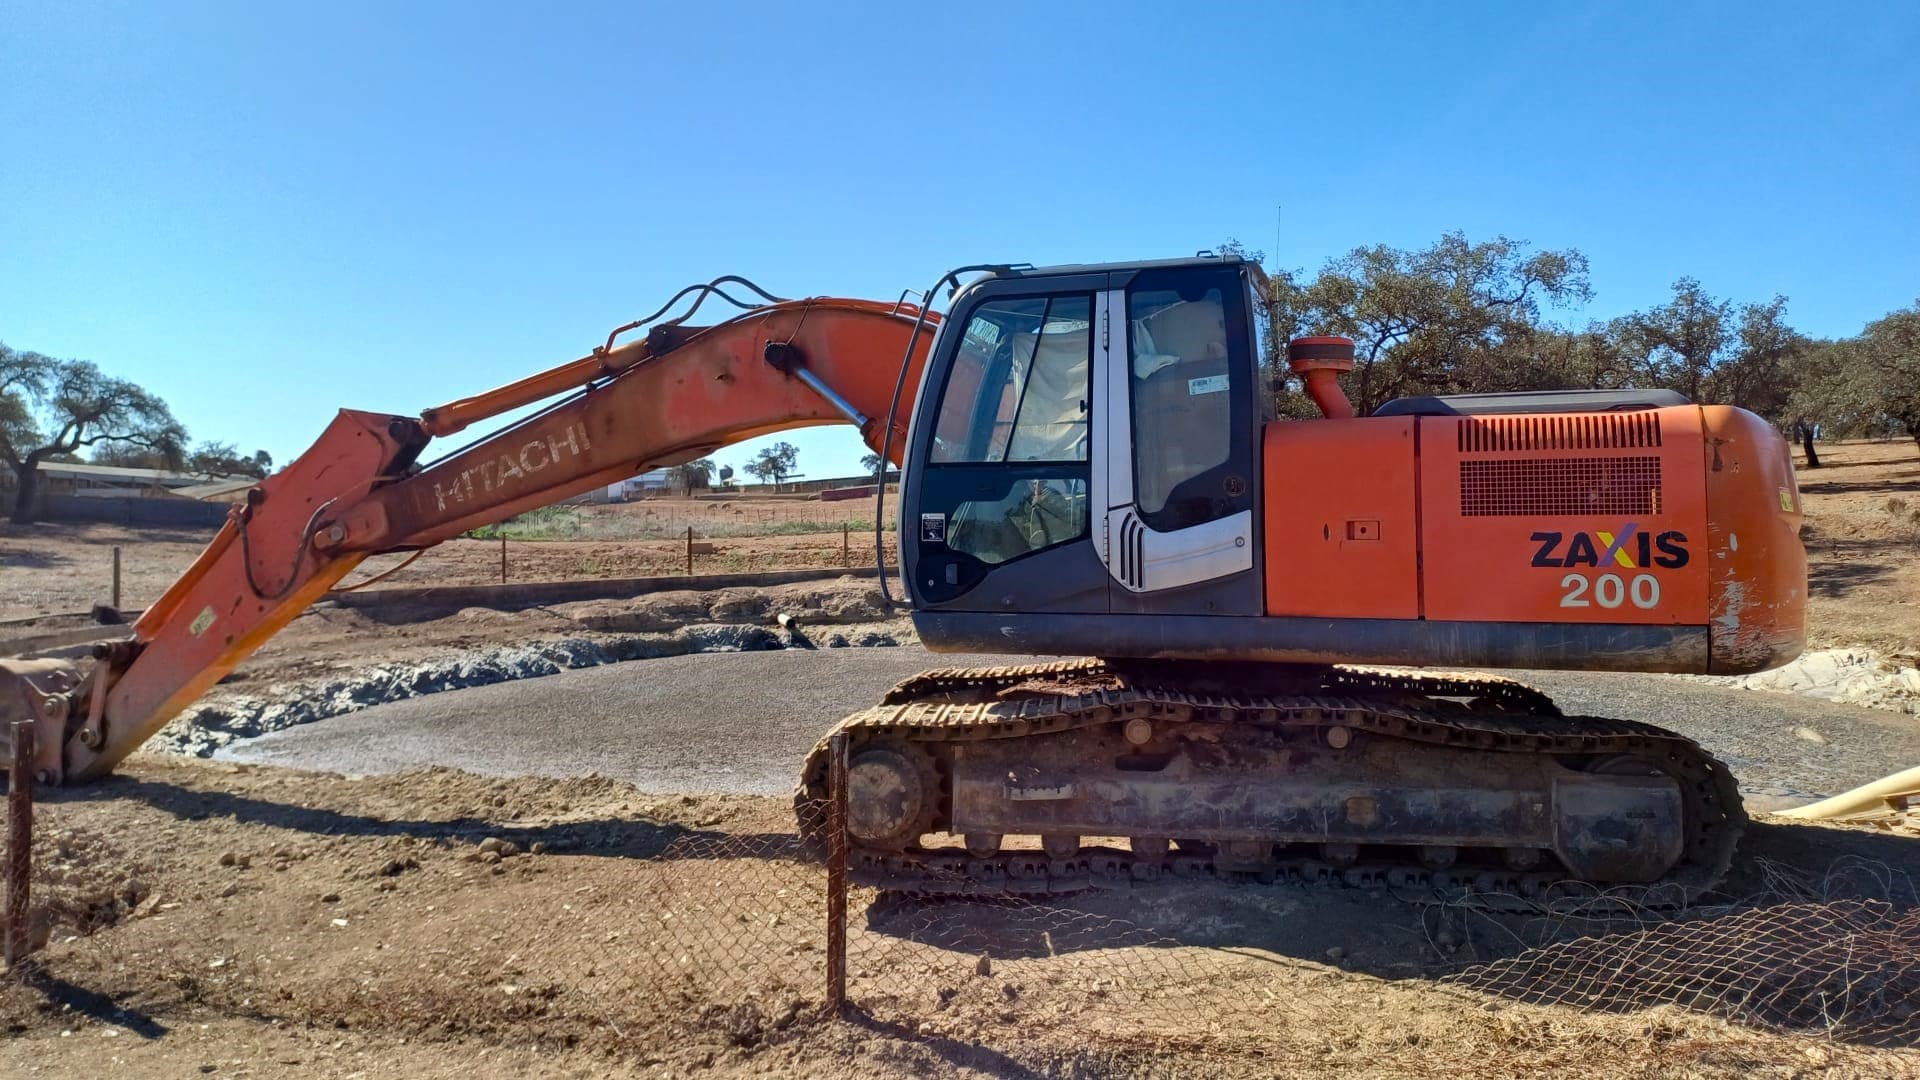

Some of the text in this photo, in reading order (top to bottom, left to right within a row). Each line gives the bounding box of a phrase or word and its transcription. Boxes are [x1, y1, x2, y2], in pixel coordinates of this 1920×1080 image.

[434, 422, 591, 512] HITACHI
[1530, 522, 1690, 569] ZAXIS
[1559, 573, 1661, 609] 200
